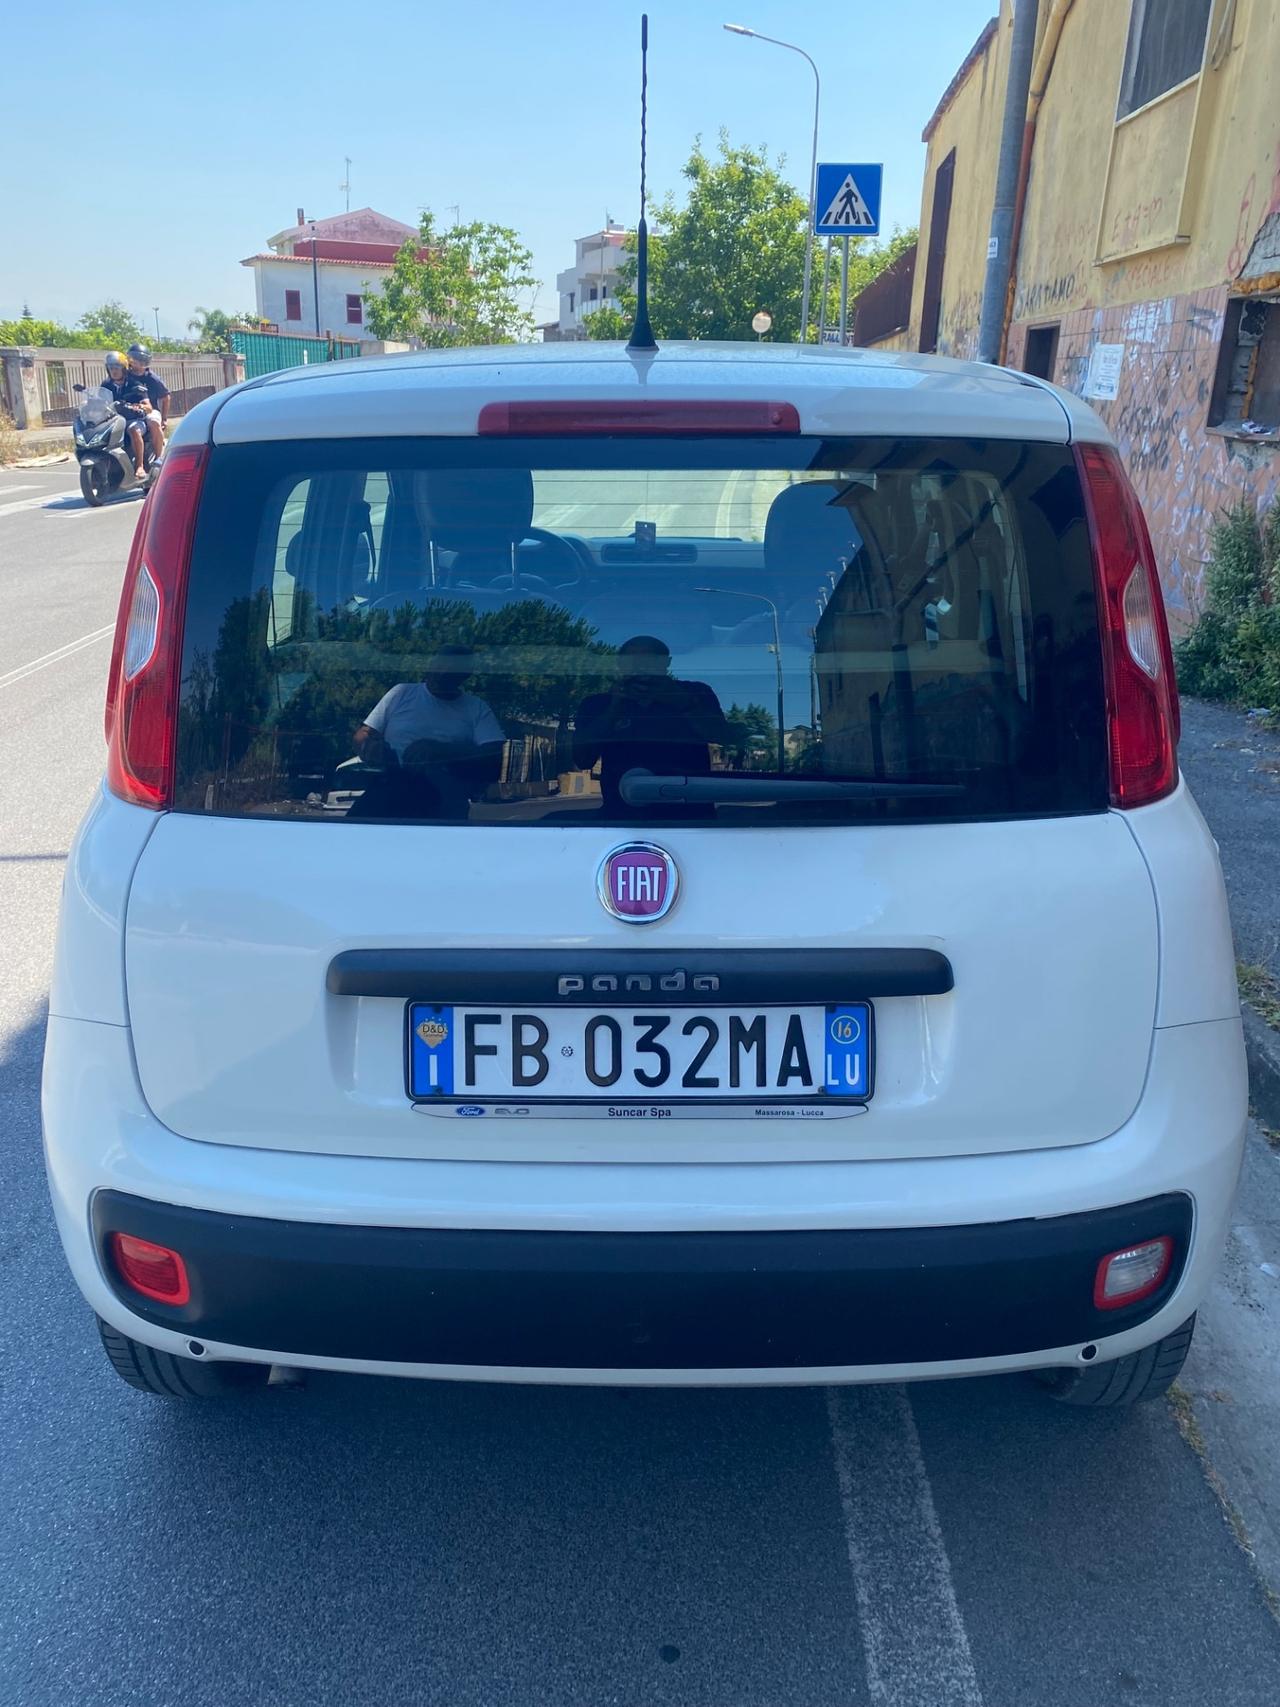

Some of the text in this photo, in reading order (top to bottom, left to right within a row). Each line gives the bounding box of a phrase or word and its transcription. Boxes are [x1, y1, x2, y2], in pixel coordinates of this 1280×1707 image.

[617, 866, 663, 901] FIAT
[558, 969, 720, 995] panda
[837, 1021, 852, 1038] 16
[464, 1014, 814, 1088] FB 032MA
[429, 1054, 438, 1086] I
[827, 1054, 860, 1086] LU
[459, 1106, 481, 1116] Ford
[608, 1107, 672, 1119] Suncar Spa
[754, 1108, 796, 1117] Massarosa
[801, 1108, 825, 1117] Lucca
